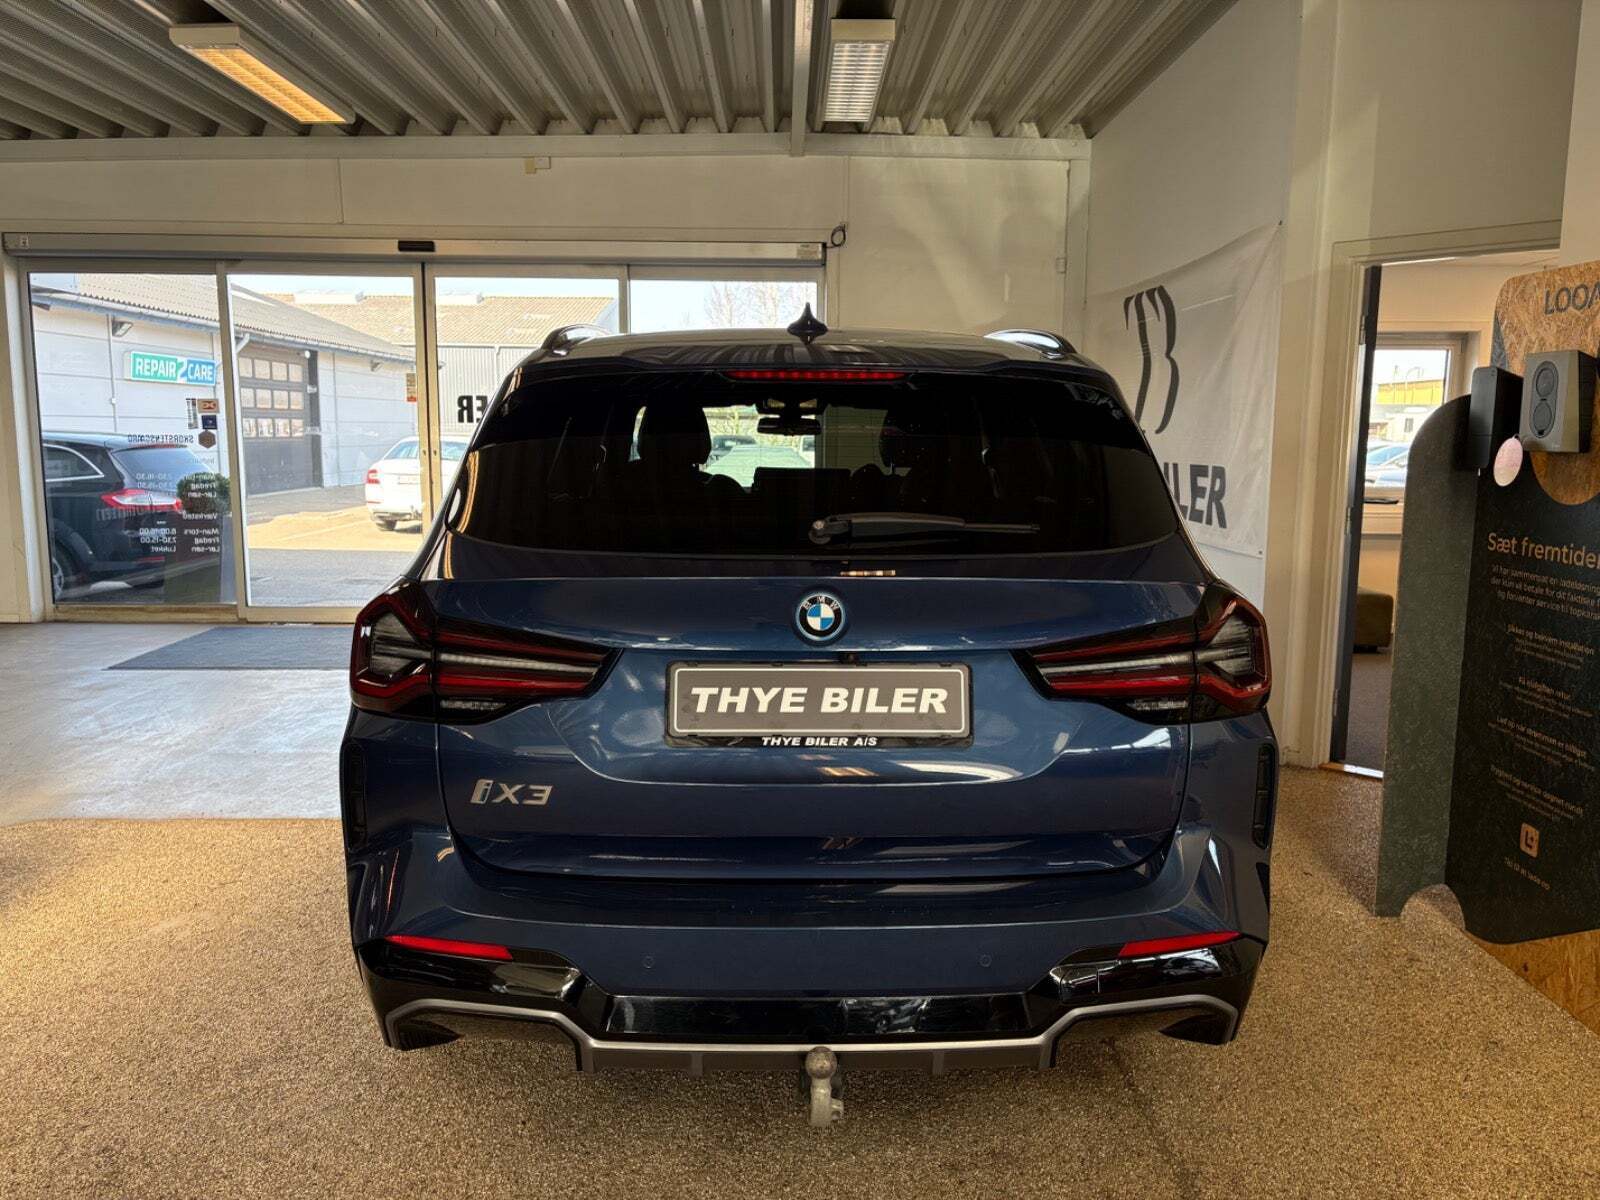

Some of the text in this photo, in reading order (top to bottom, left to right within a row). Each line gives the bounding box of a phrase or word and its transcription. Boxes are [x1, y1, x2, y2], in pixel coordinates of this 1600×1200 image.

[1487, 532, 1600, 570] Sæt fremtide
[691, 687, 949, 713] THYE BILER
[761, 736, 877, 747] THYE BILER A/S
[470, 779, 553, 805] iX3
